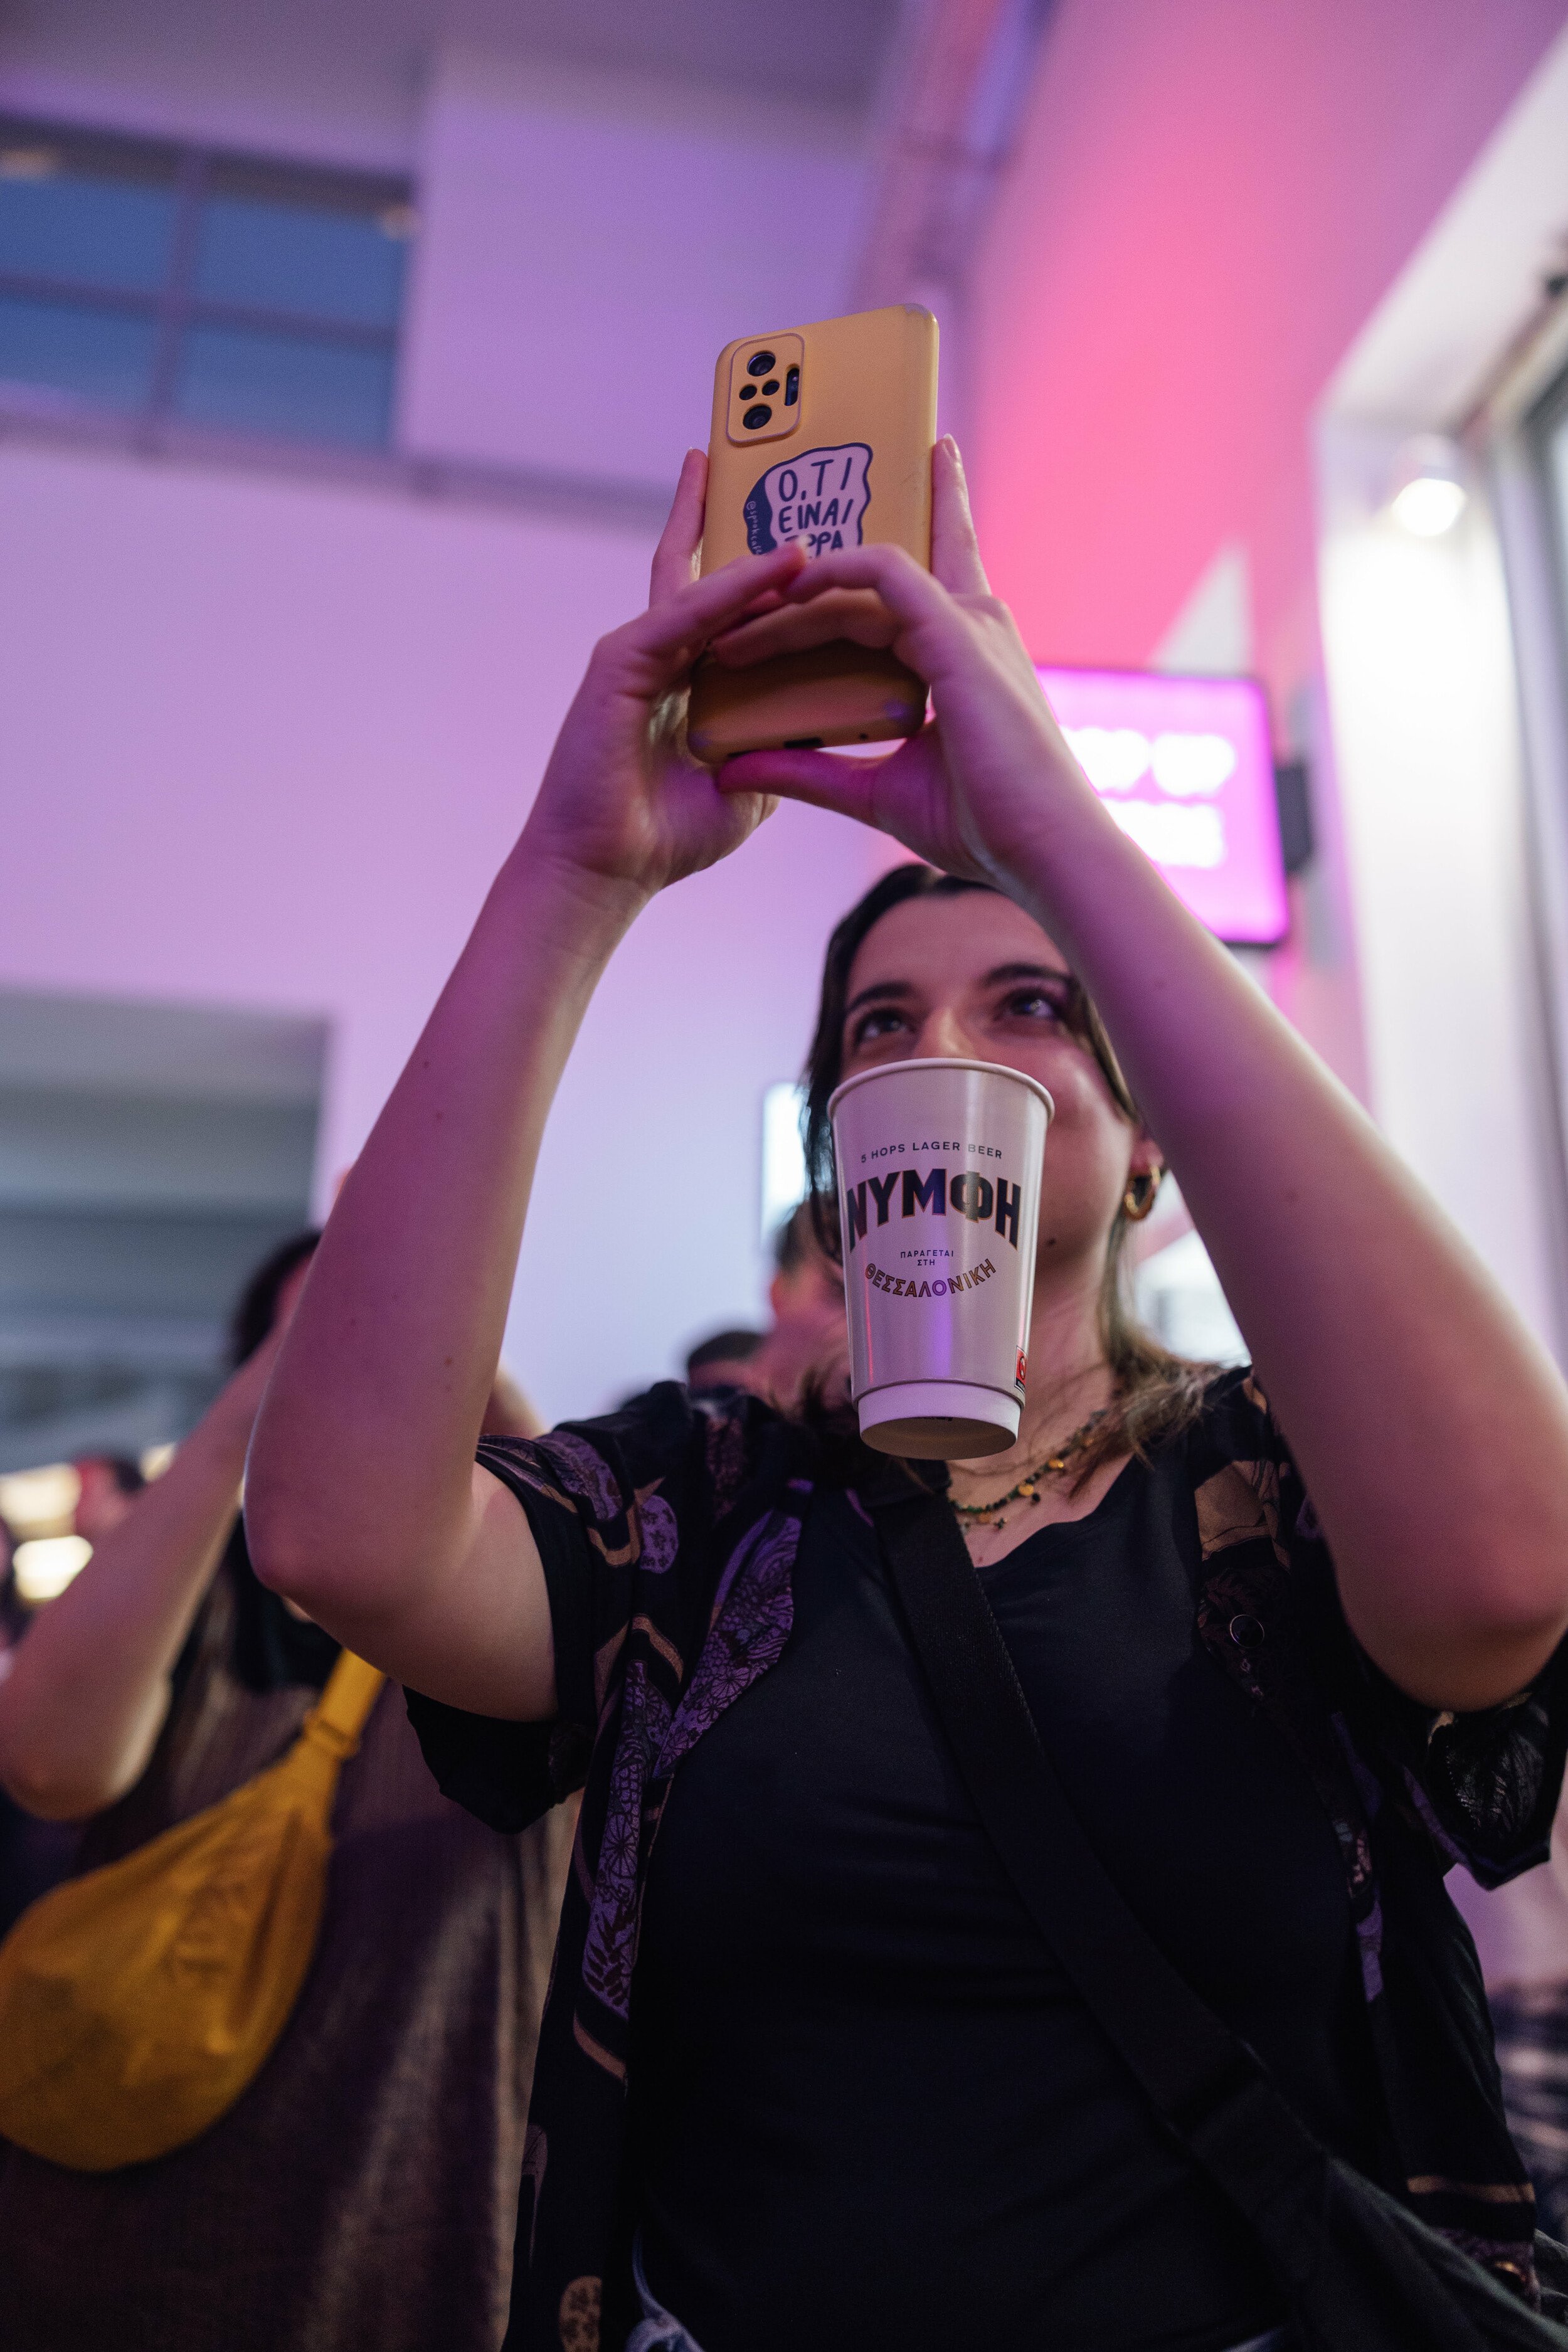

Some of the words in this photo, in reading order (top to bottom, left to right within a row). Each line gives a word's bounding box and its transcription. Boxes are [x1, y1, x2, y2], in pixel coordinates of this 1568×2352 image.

[779, 498, 854, 533] ΕΙΝΑΙ
[861, 1155, 867, 1163] 5
[871, 1143, 905, 1160] HOPS
[912, 1141, 960, 1151] LAGER
[968, 1143, 1003, 1159] BEER
[846, 1168, 1021, 1253] ΝΥΜΦΗ
[900, 1249, 954, 1259] ΠΑΡΑΓΕΤΑΙ
[865, 1258, 997, 1298] ΘΕΣΣΑΛΟΝΙΚΗ
